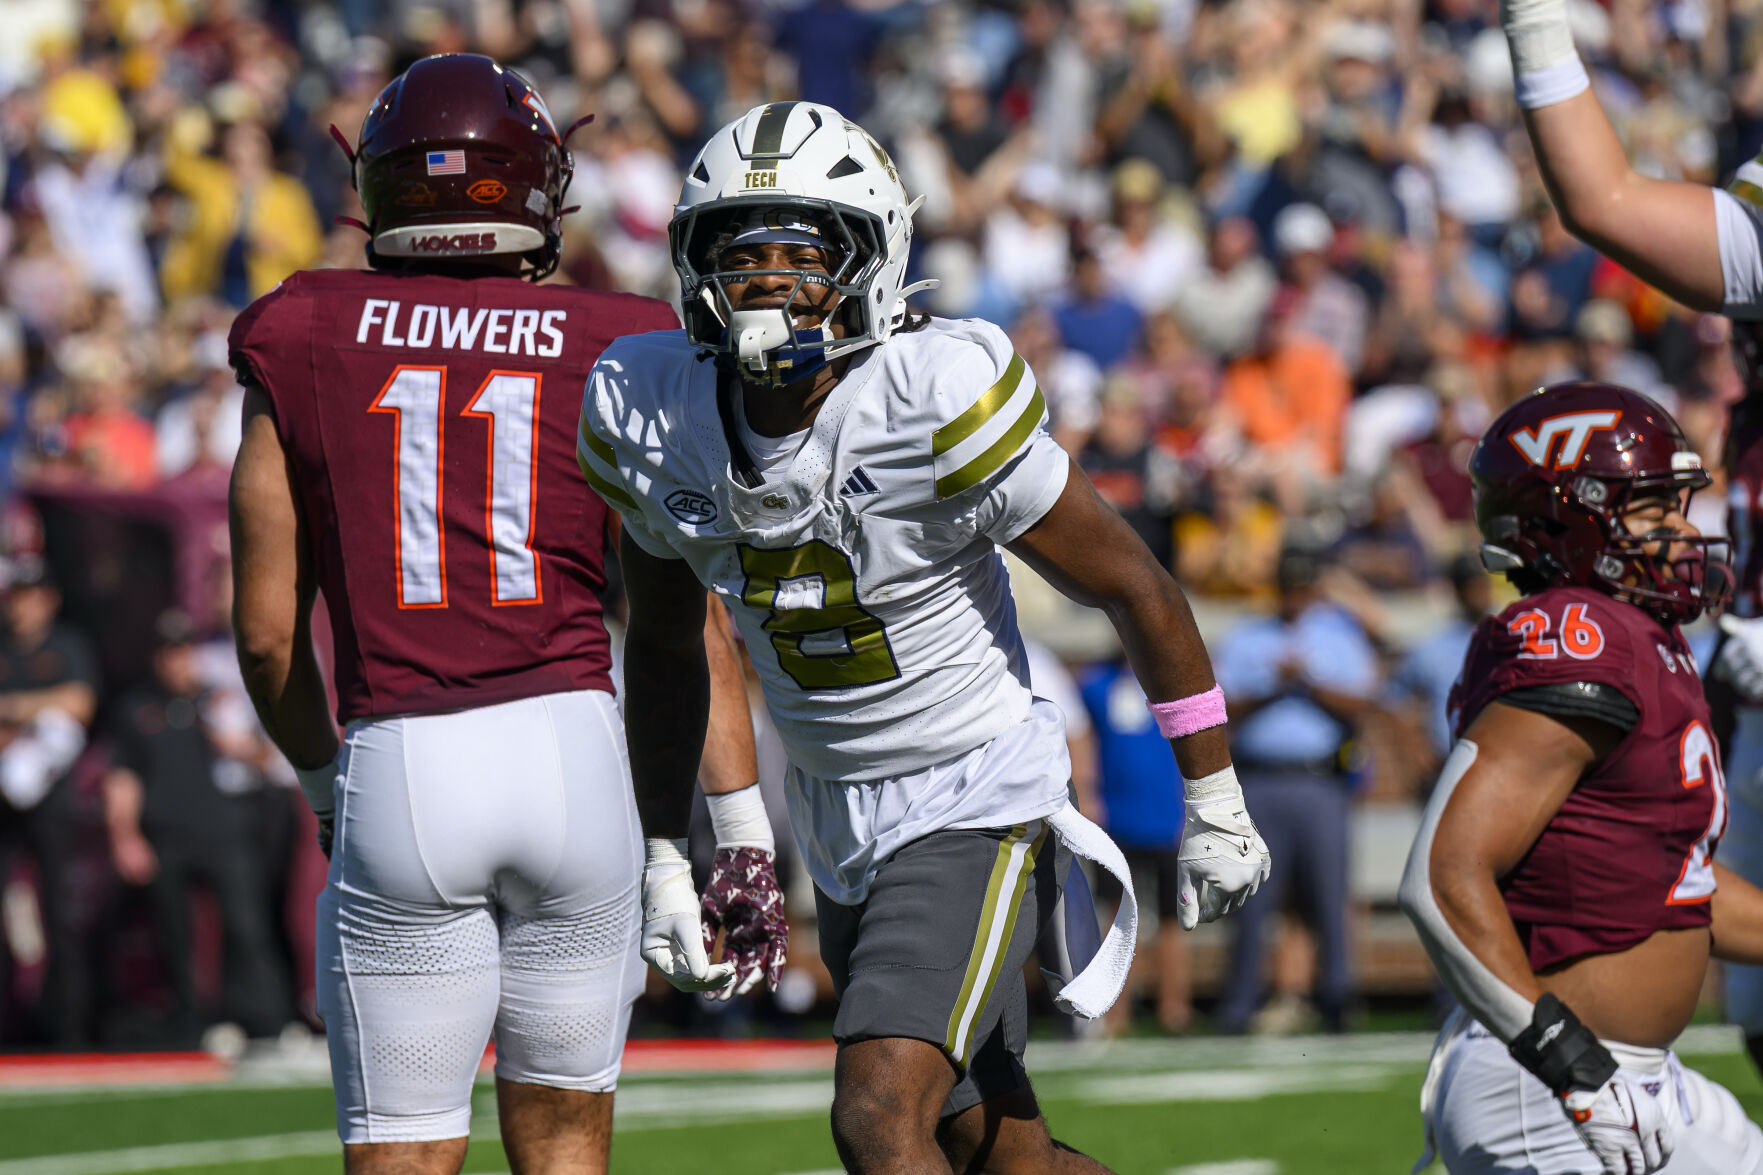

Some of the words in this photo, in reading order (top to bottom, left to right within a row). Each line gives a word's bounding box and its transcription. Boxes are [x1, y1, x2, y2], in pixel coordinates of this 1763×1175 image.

[745, 171, 777, 188] TECH
[411, 232, 497, 252] HOKIES
[356, 298, 567, 358] FLOWERS
[1507, 408, 1623, 472] VT
[367, 364, 543, 609] 11
[737, 538, 901, 690] 8
[1507, 602, 1605, 661] 26
